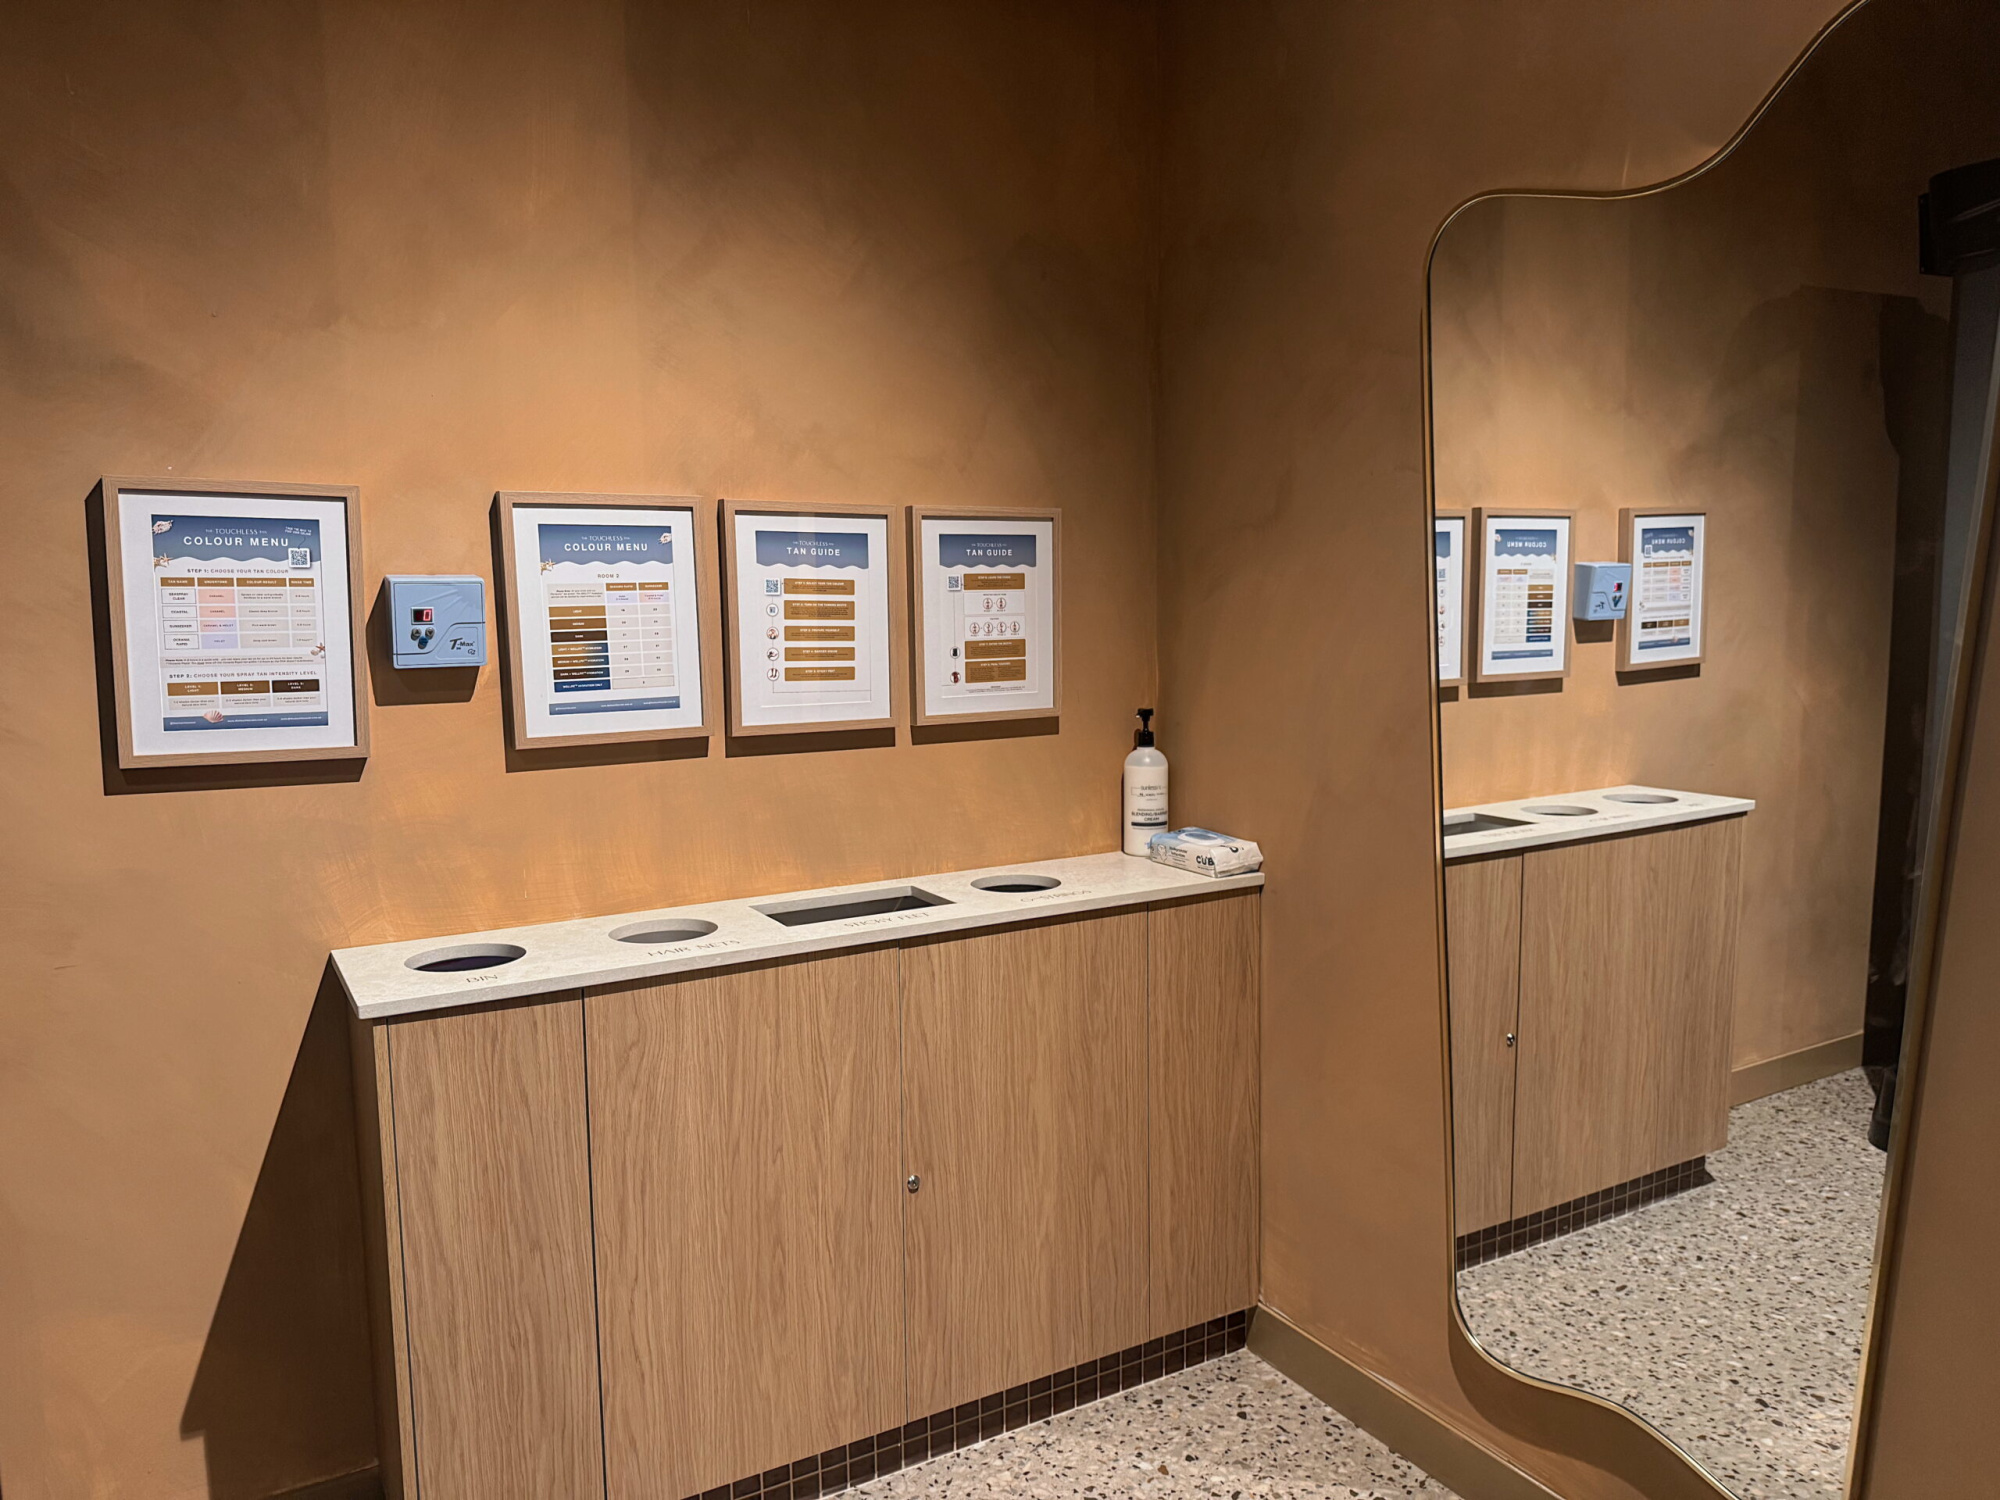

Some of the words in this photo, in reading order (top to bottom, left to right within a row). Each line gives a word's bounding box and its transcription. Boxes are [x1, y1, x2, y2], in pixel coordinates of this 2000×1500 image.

[183, 536, 243, 546] COLOUR
[250, 537, 288, 547] MENU
[564, 543, 612, 552] COLOUR
[617, 543, 648, 552] MENU
[786, 547, 807, 555] TAN
[810, 547, 841, 556] GUIDE
[647, 947, 692, 957] HAIR
[697, 940, 741, 950] NETS
[466, 974, 498, 983] BIN
